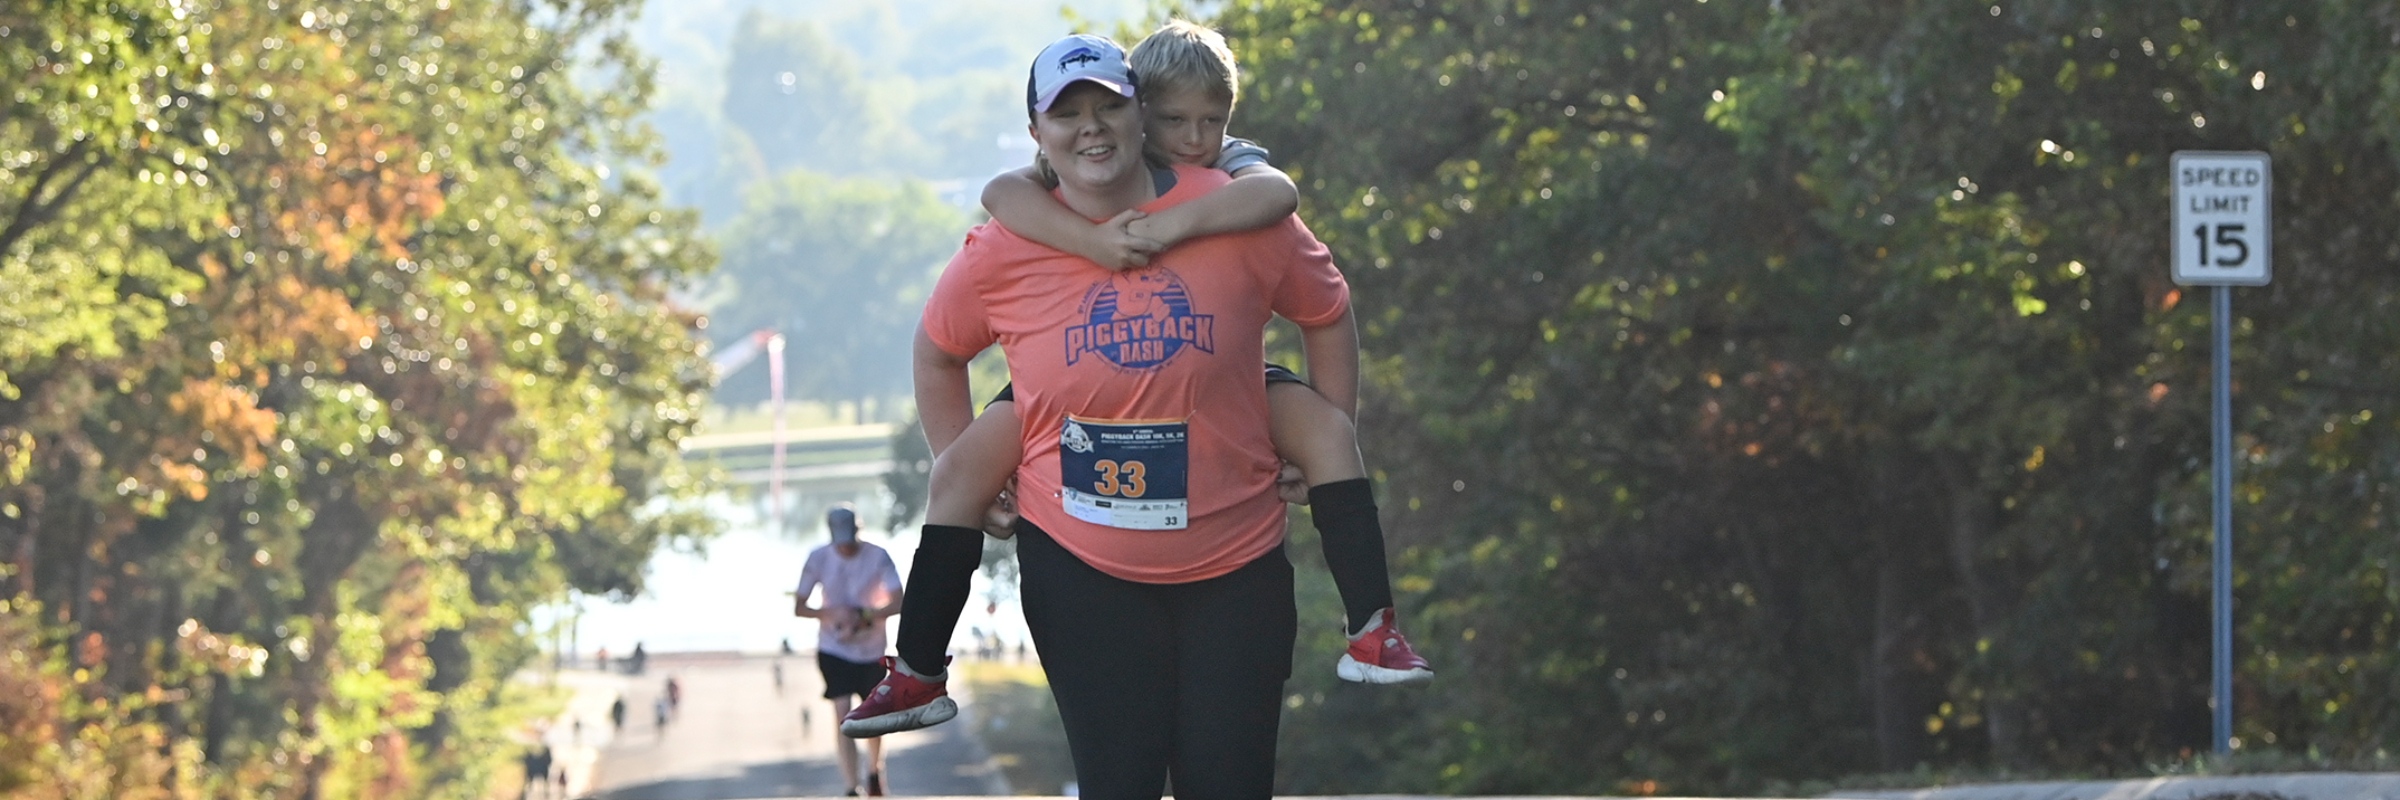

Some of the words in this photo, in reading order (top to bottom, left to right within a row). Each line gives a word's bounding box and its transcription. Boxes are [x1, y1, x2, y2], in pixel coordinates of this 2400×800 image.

[2182, 167, 2260, 187] SPEED
[2190, 195, 2251, 213] LIMIT
[2194, 222, 2249, 268] 15
[1066, 314, 1213, 366] PIGGYBACK
[1119, 340, 1164, 364] DASH
[1094, 459, 1146, 498] 33
[1165, 516, 1178, 526] 33
